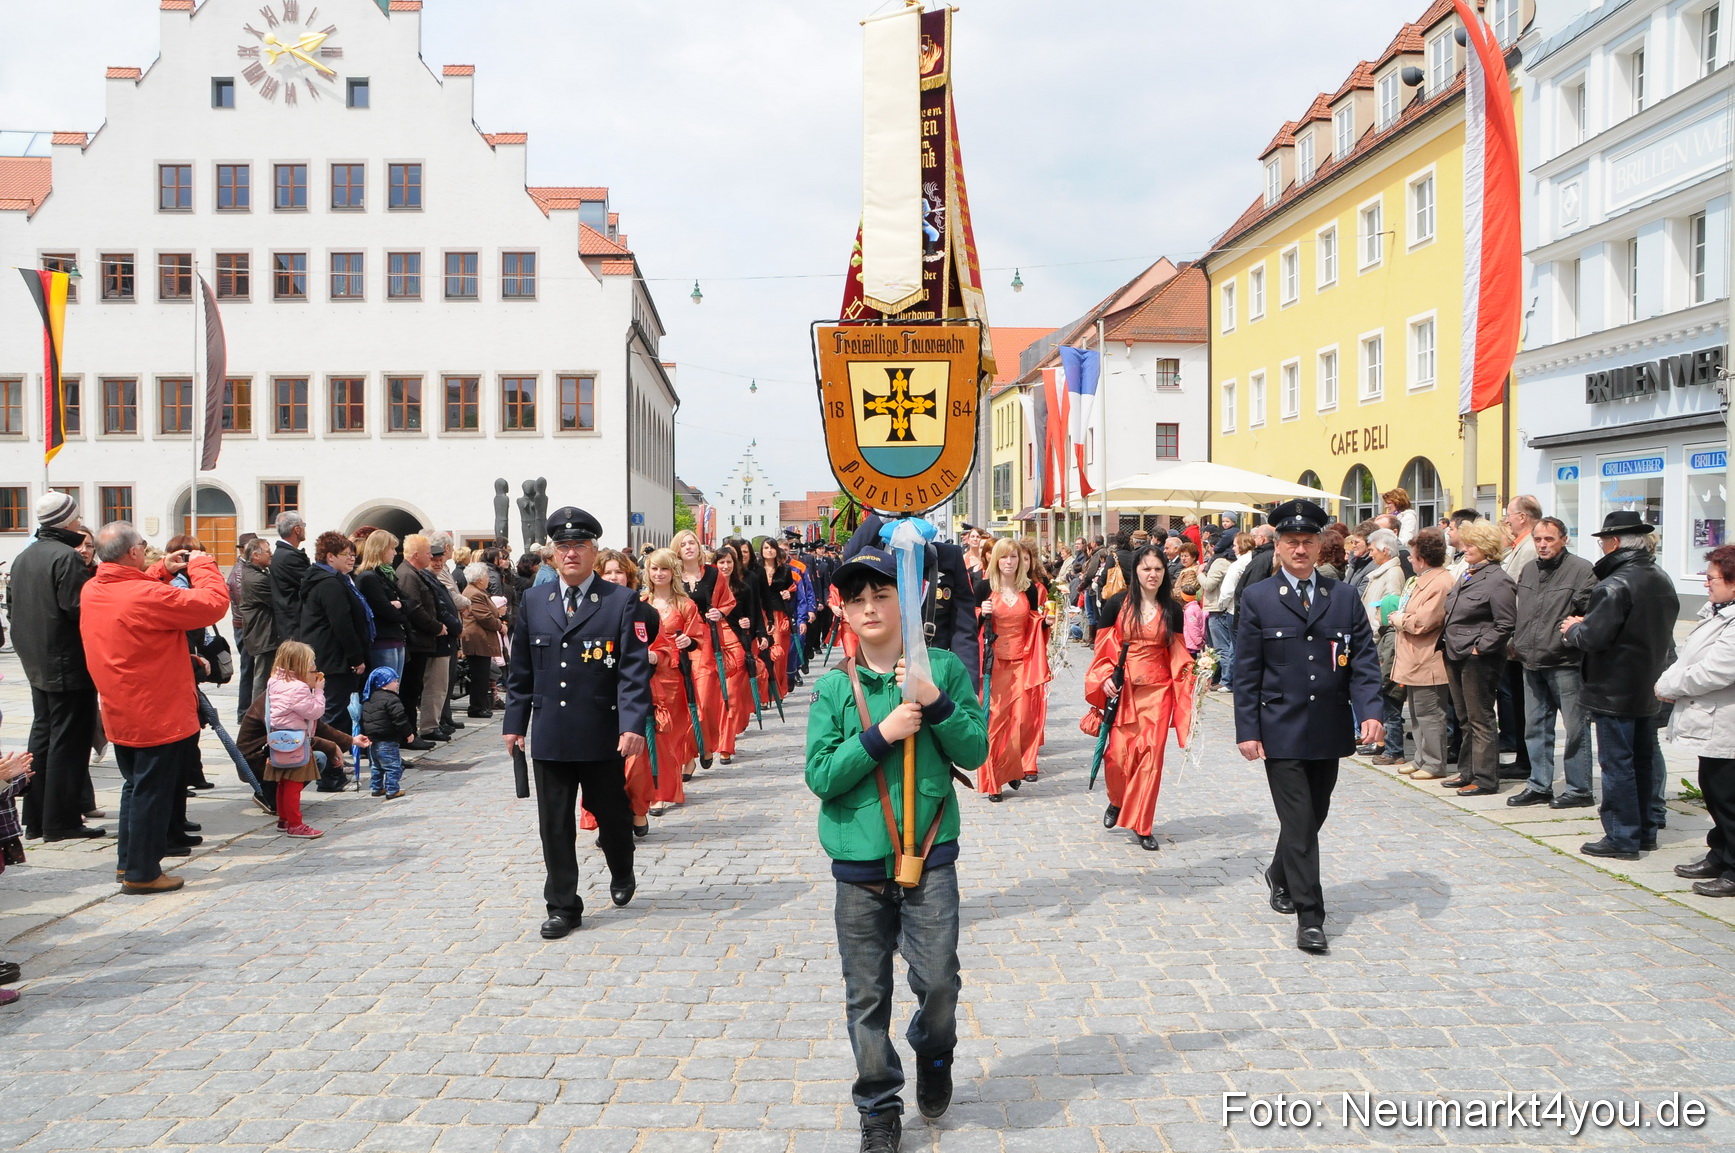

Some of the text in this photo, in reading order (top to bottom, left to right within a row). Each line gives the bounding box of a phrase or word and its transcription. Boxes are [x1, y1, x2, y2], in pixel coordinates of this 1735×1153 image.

[1616, 135, 1689, 194] BRILLEN
[833, 330, 965, 357] Freiwillige Feuerwehr
[1585, 359, 1670, 404] BRILLEN
[828, 401, 845, 418] 18
[952, 400, 973, 418] 84
[1330, 423, 1388, 456] CAFE DELI
[1605, 459, 1661, 475] BRILLEN WEBER
[838, 459, 958, 507] Pavelsbach
